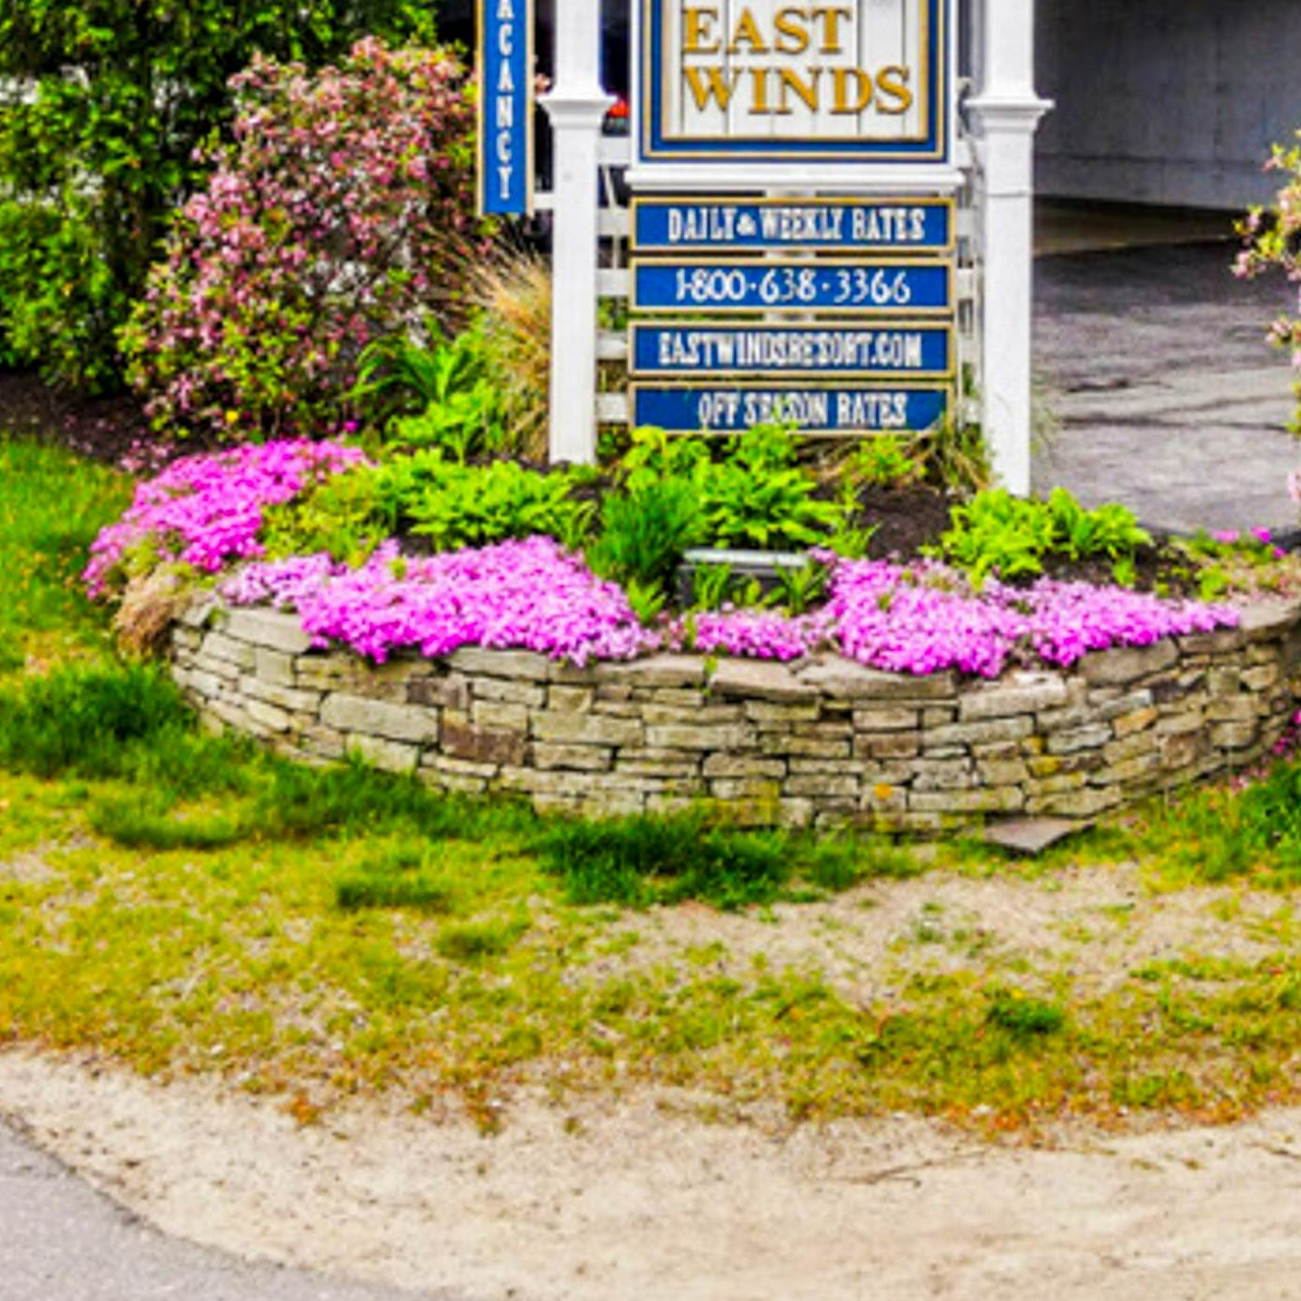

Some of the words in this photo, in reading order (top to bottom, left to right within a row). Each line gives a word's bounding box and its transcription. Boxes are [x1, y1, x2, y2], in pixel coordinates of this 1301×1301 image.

[681, 6, 851, 55] EAST
[681, 65, 914, 116] WINDS
[668, 207, 737, 241] DAILY
[758, 207, 844, 241] WEEKLY
[852, 207, 926, 241] RATES
[658, 332, 922, 368] EASTWINDSRESORT.COM
[699, 392, 740, 426] OFF
[743, 391, 828, 427] SEASON
[836, 392, 908, 426] RATES
